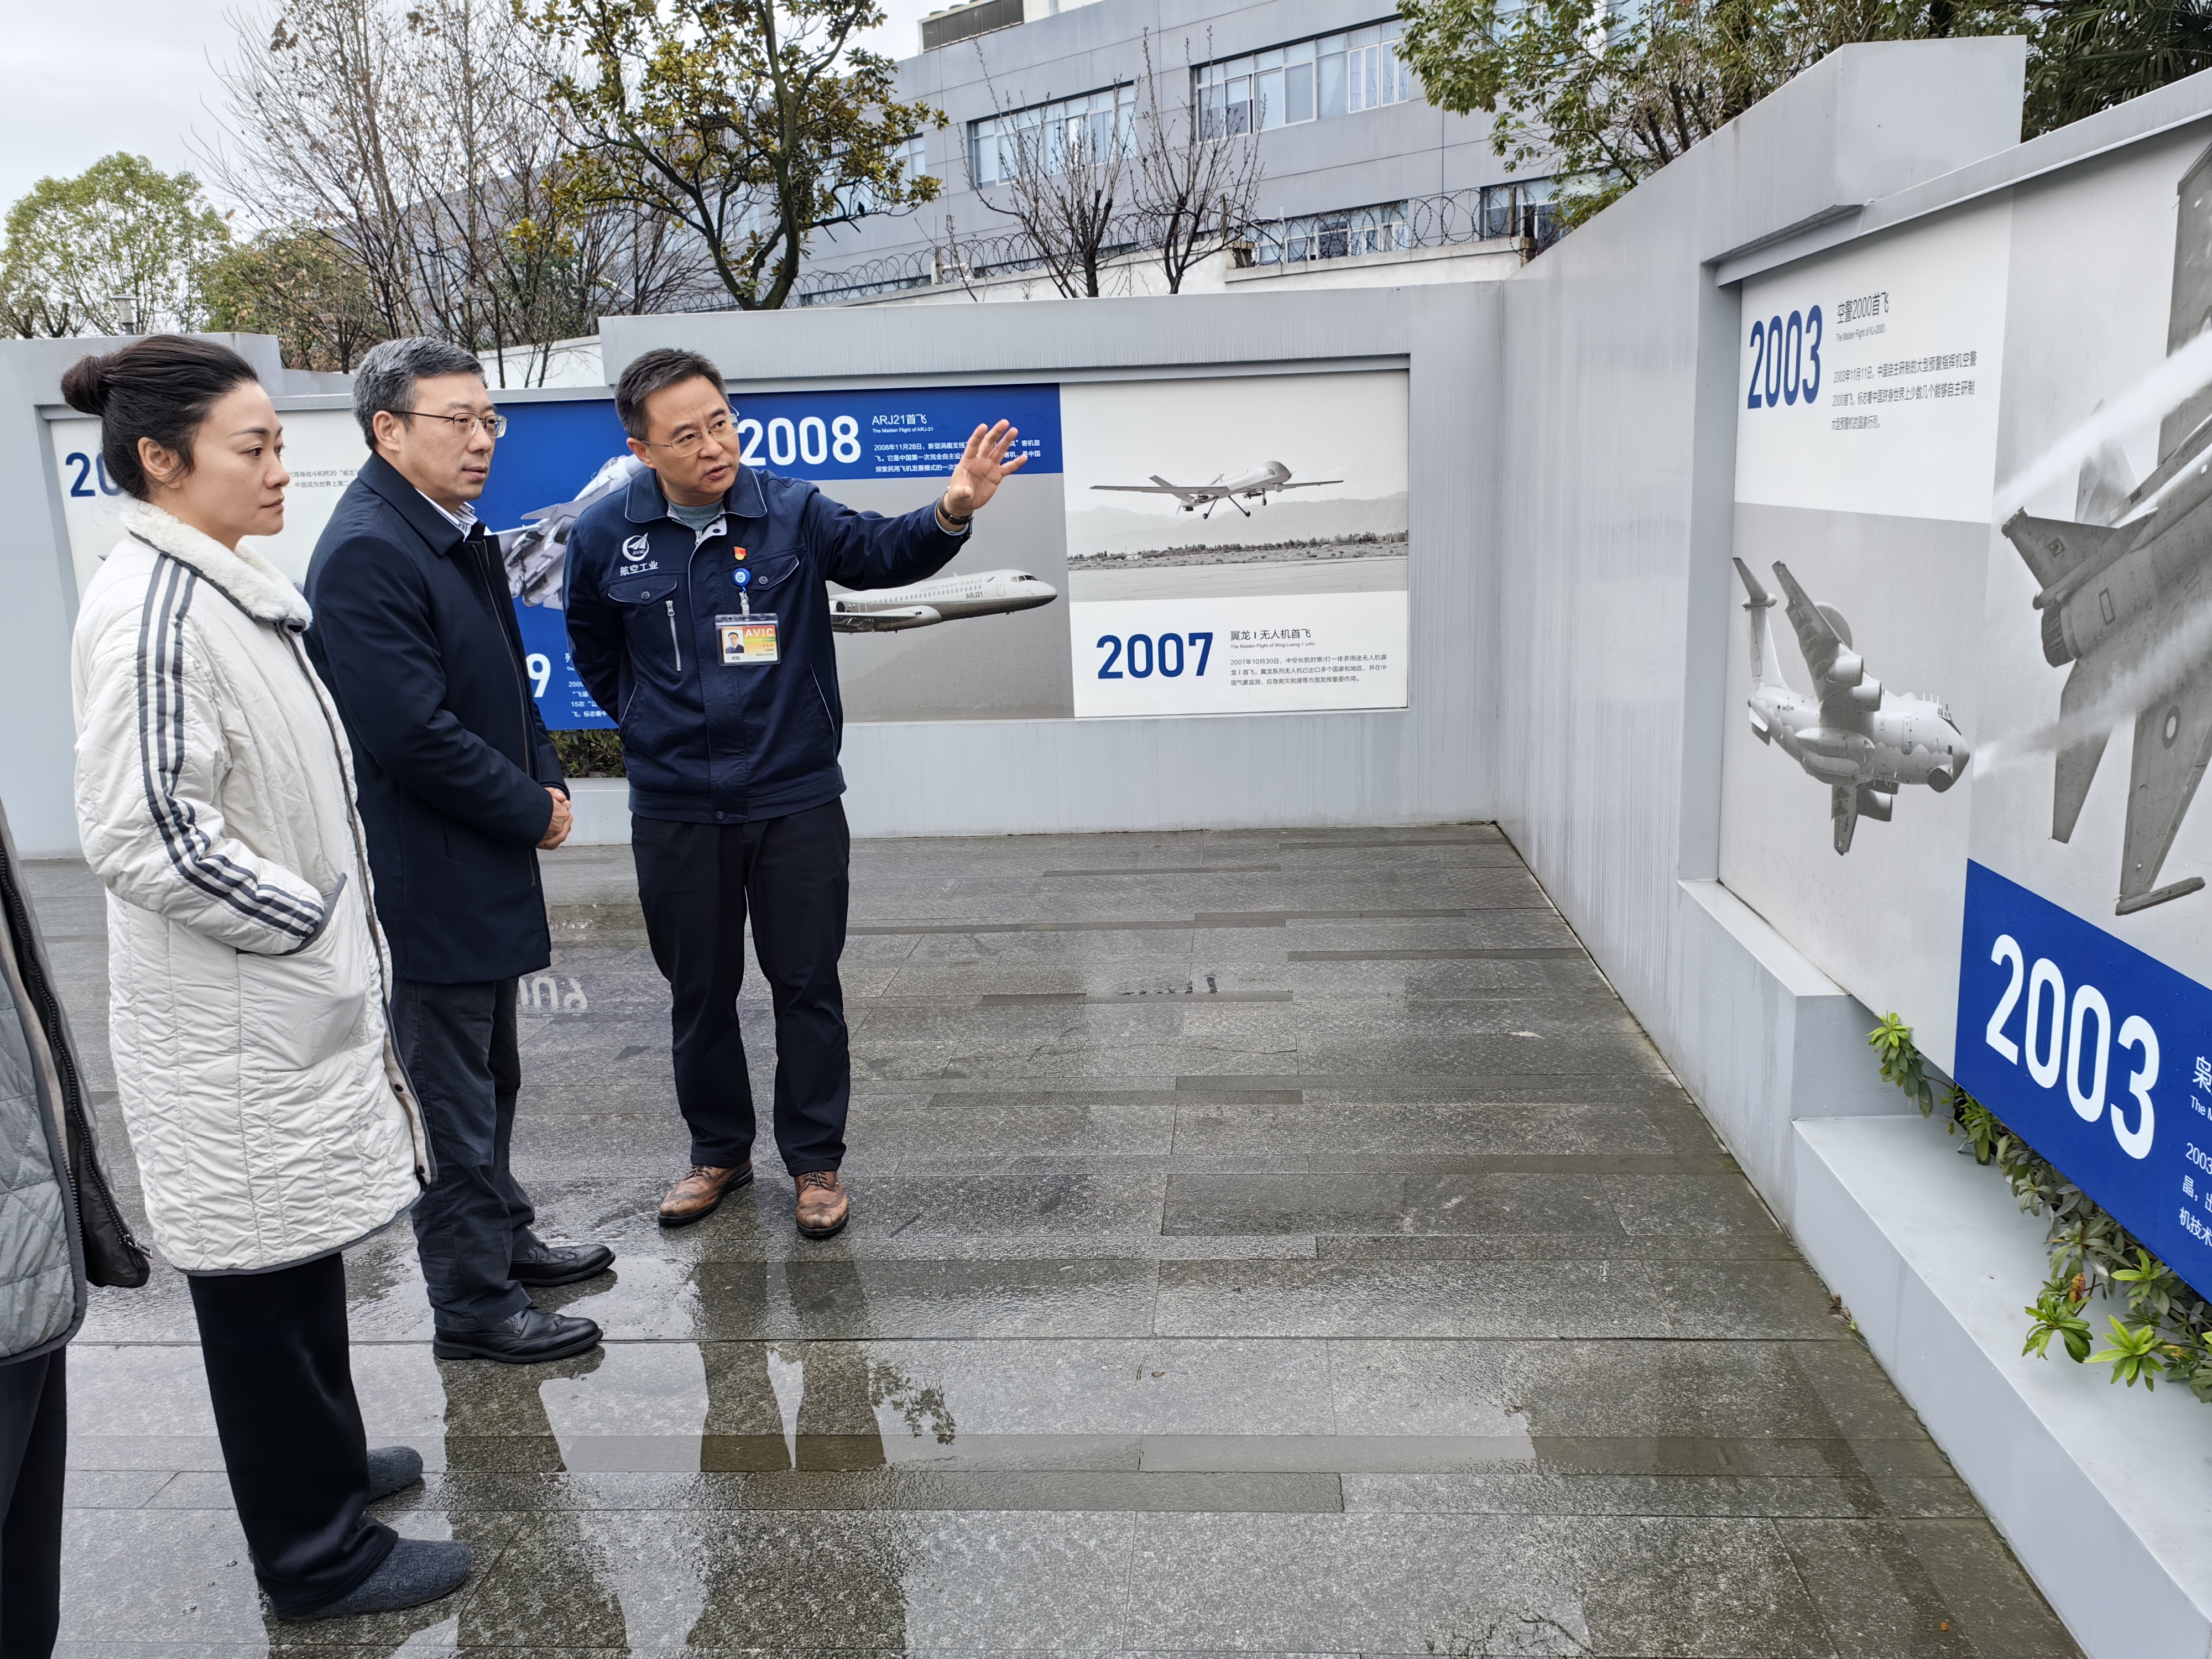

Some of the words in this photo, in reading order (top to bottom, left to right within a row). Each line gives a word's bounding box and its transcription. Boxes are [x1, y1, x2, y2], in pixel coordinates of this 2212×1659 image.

[1837, 291, 1888, 324] 空警2000首飞
[1747, 305, 1822, 409] 2003
[872, 414, 927, 425] ARJ21首飞
[737, 415, 861, 466] 2008
[620, 560, 659, 576] 航空工业
[966, 591, 983, 599] ARJ21
[745, 628, 774, 638] AVIC
[1096, 632, 1213, 679] 2007
[1986, 934, 2159, 1159] 2003
[2190, 1095, 2206, 1115] The
